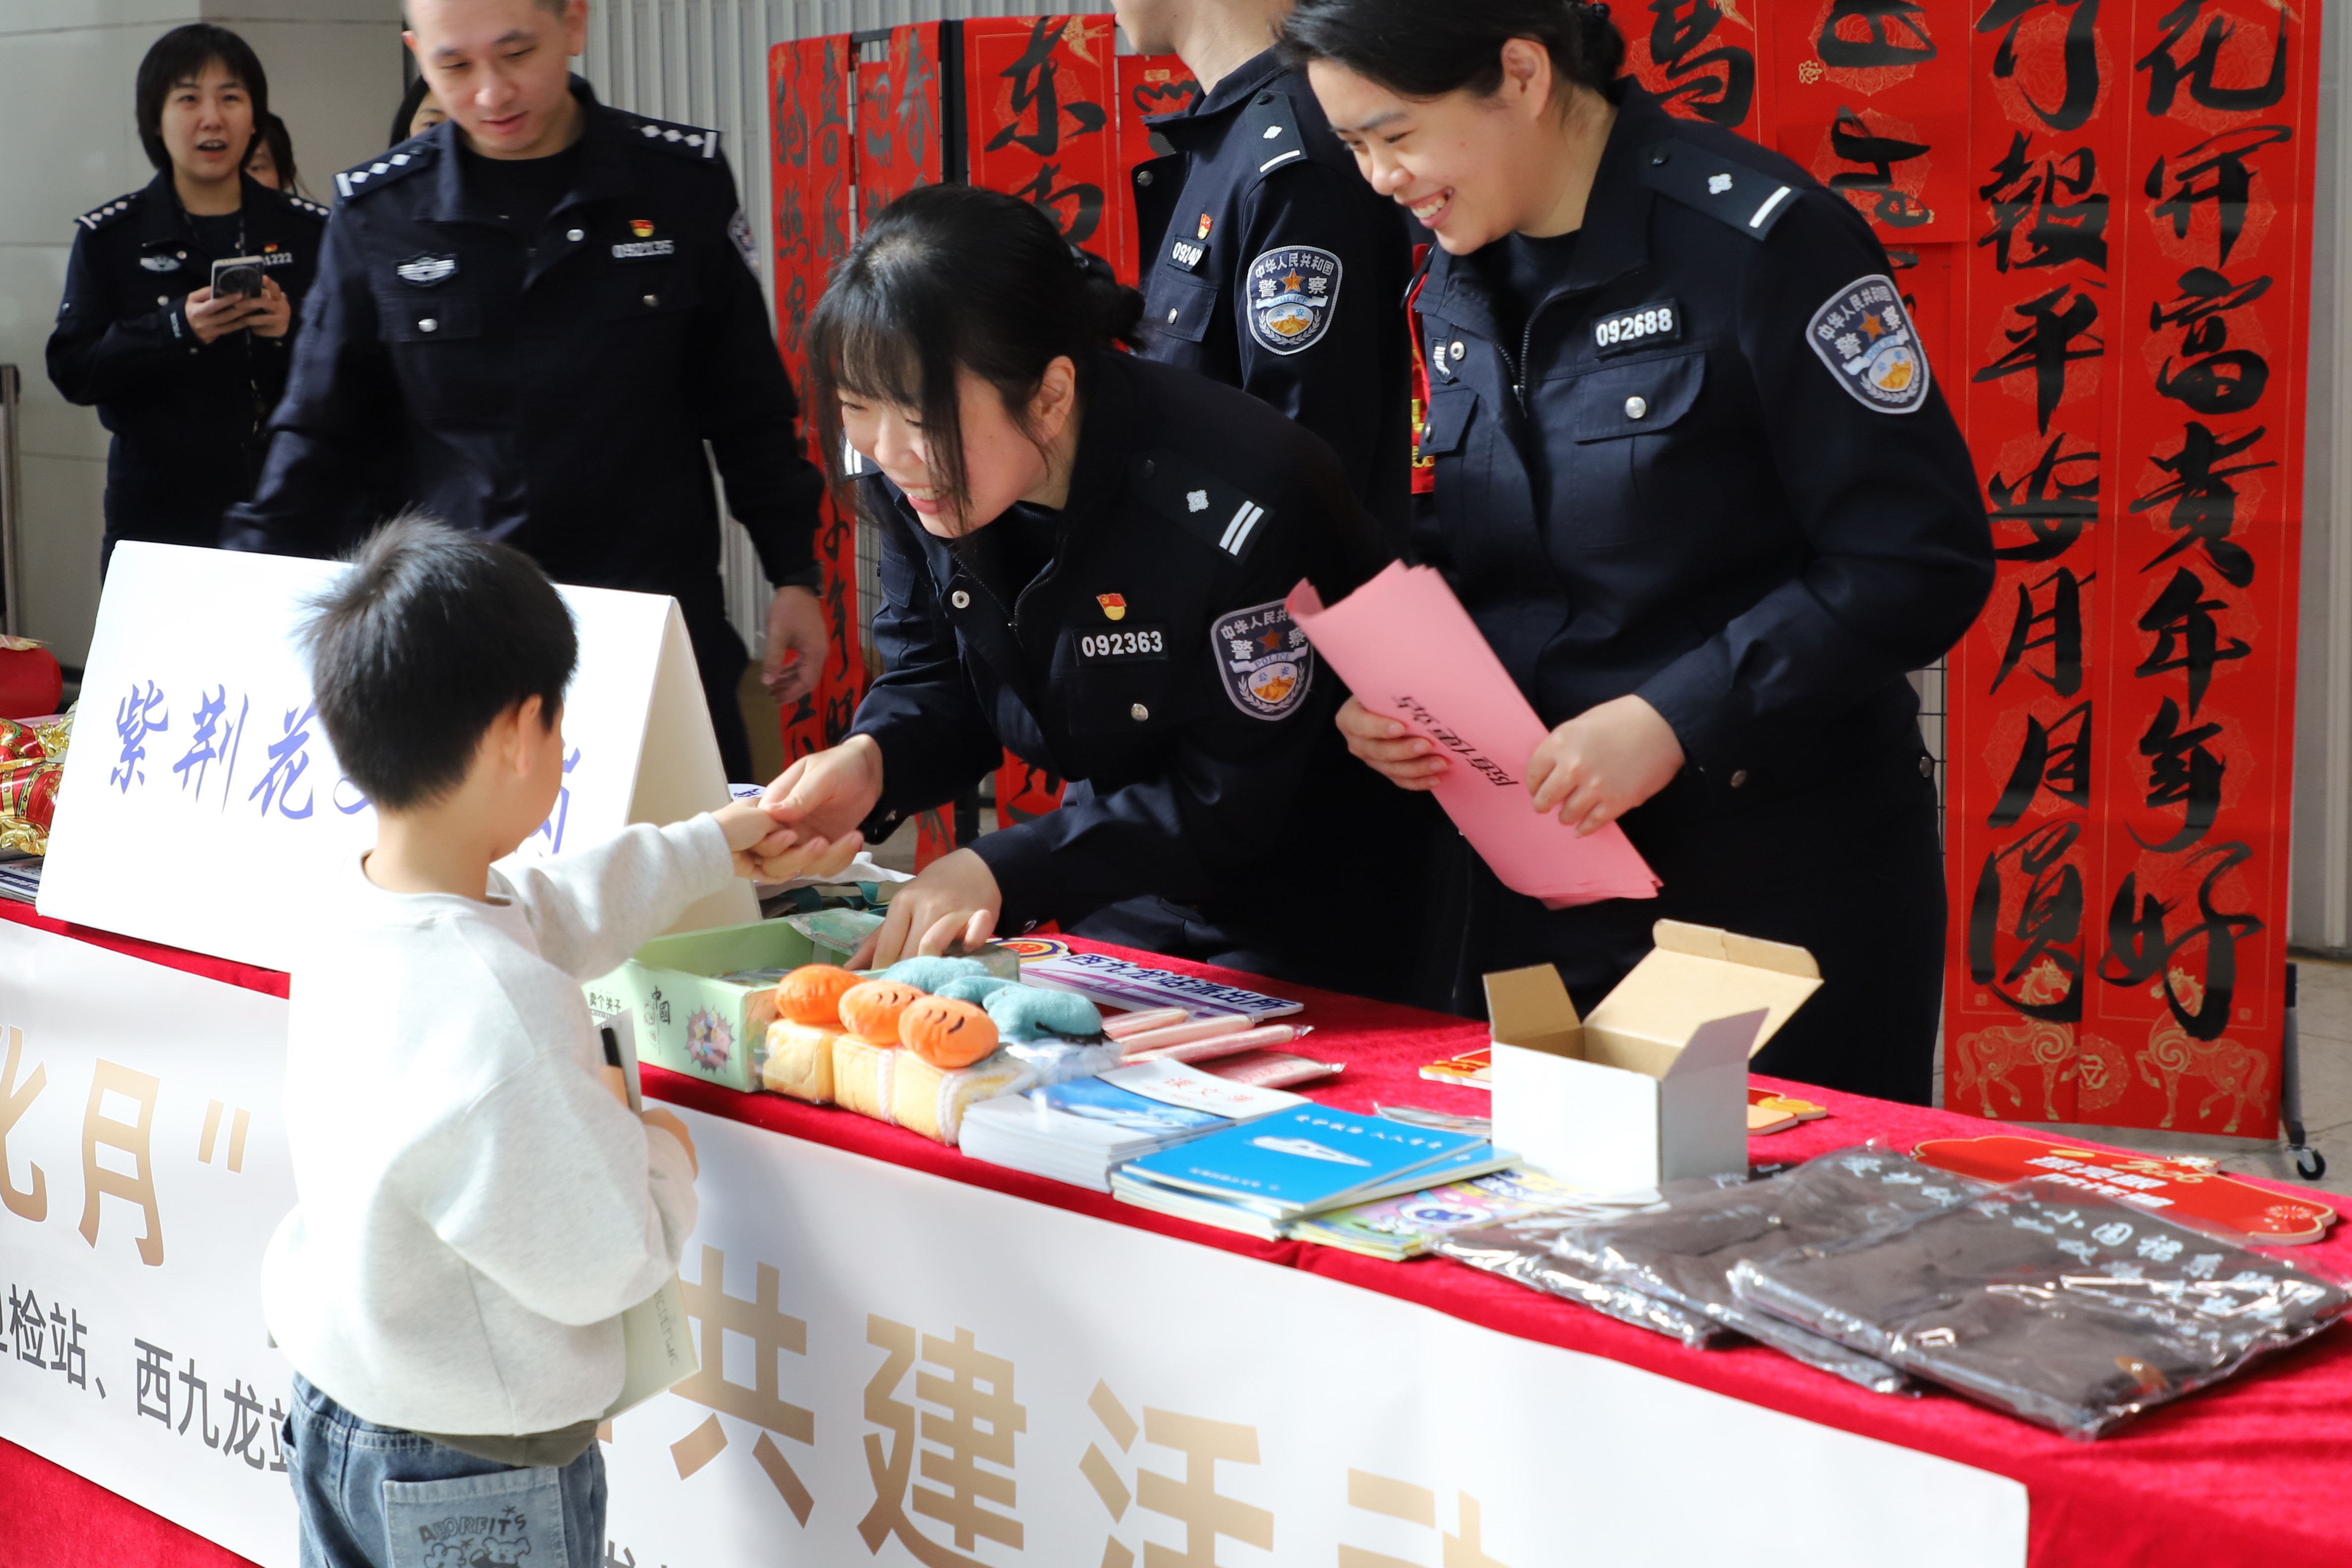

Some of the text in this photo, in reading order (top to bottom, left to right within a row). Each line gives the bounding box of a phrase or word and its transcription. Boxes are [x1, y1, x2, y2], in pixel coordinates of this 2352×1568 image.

[264, 252, 293, 266] 1222
[1255, 252, 1334, 278] 中华人民共和国
[1274, 296, 1309, 305] POLICE
[1595, 307, 1673, 347] 092688
[1221, 609, 1293, 640] 中华人民共
[1081, 631, 1163, 658] 092363
[1255, 652, 1293, 668] POLICE
[1061, 953, 1296, 1011] 西九龙站派出所
